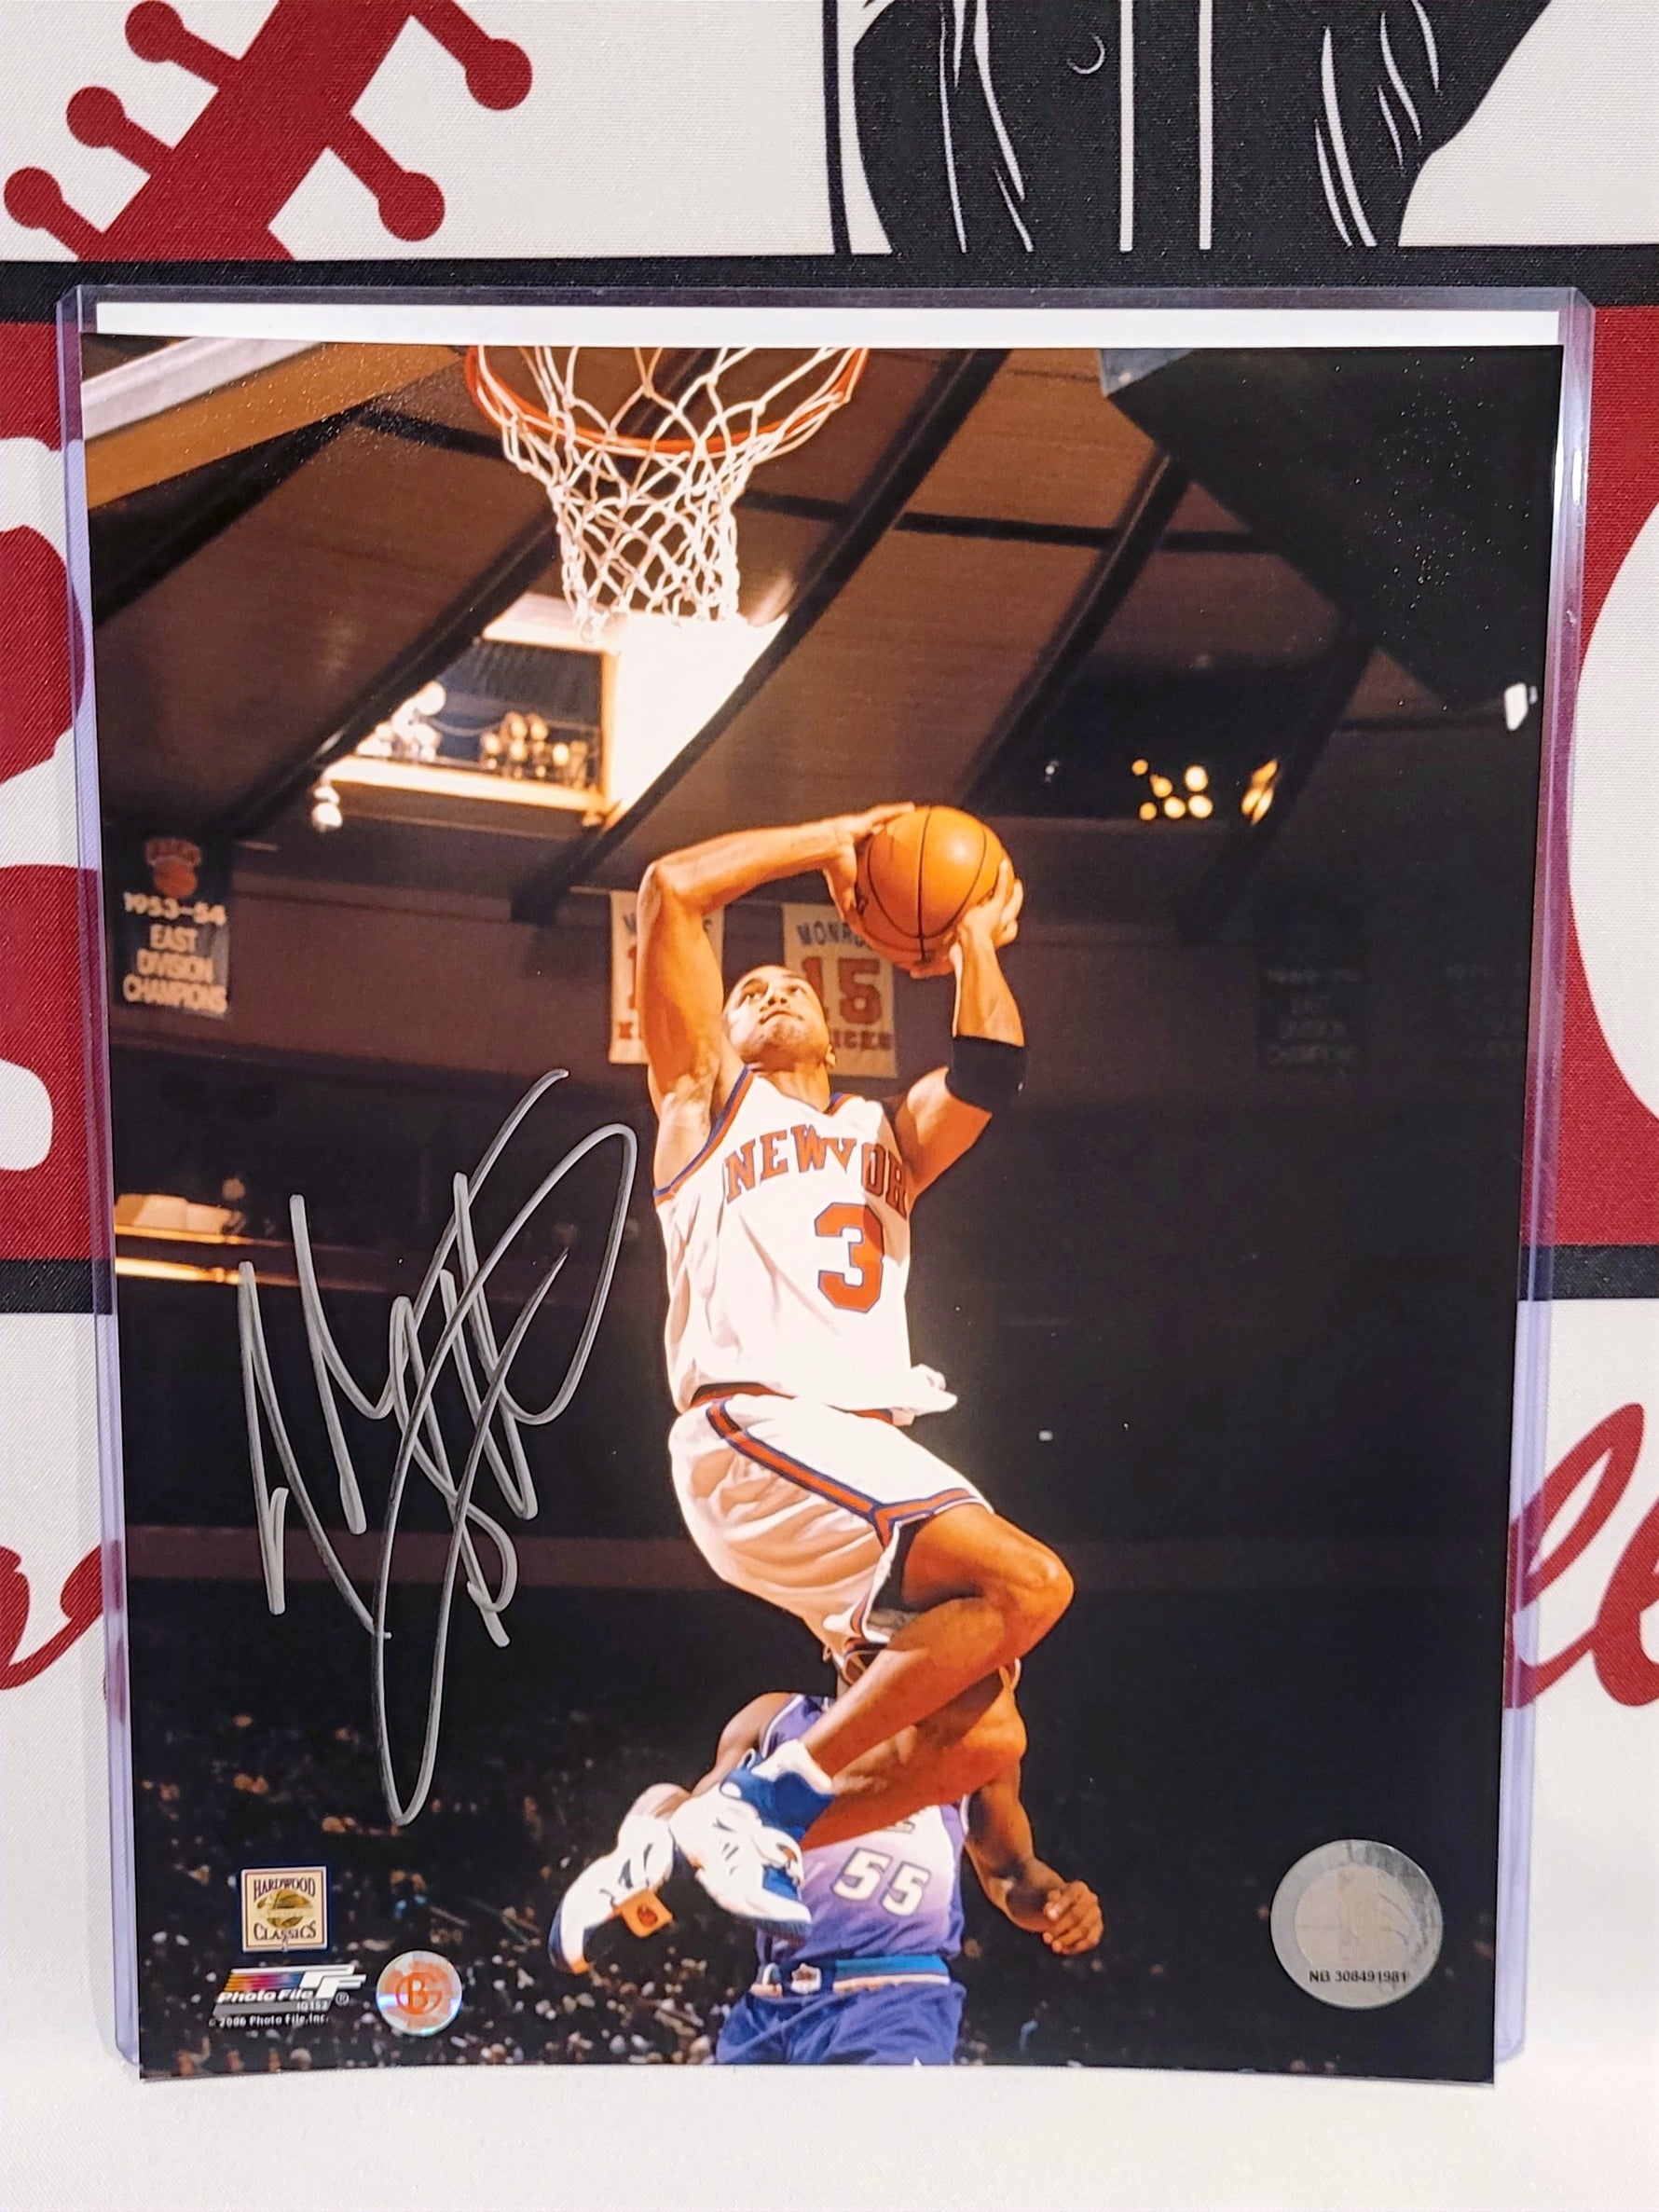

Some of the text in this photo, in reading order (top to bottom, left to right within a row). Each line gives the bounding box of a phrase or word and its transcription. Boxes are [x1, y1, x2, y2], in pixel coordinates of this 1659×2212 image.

[150, 924, 198, 953] EAST
[137, 949, 214, 983] DIVISION
[123, 974, 227, 1014] CHAMPIONS
[724, 1124, 828, 1204] NEW
[814, 1202, 884, 1313] 3
[253, 1876, 316, 1903] HARDWOOD
[830, 1847, 931, 1917] 55
[253, 1920, 317, 1942] CLASSICS
[1309, 1970, 1330, 1983] NB
[216, 1987, 314, 2004] Photo File
[249, 2014, 282, 2027] Photo
